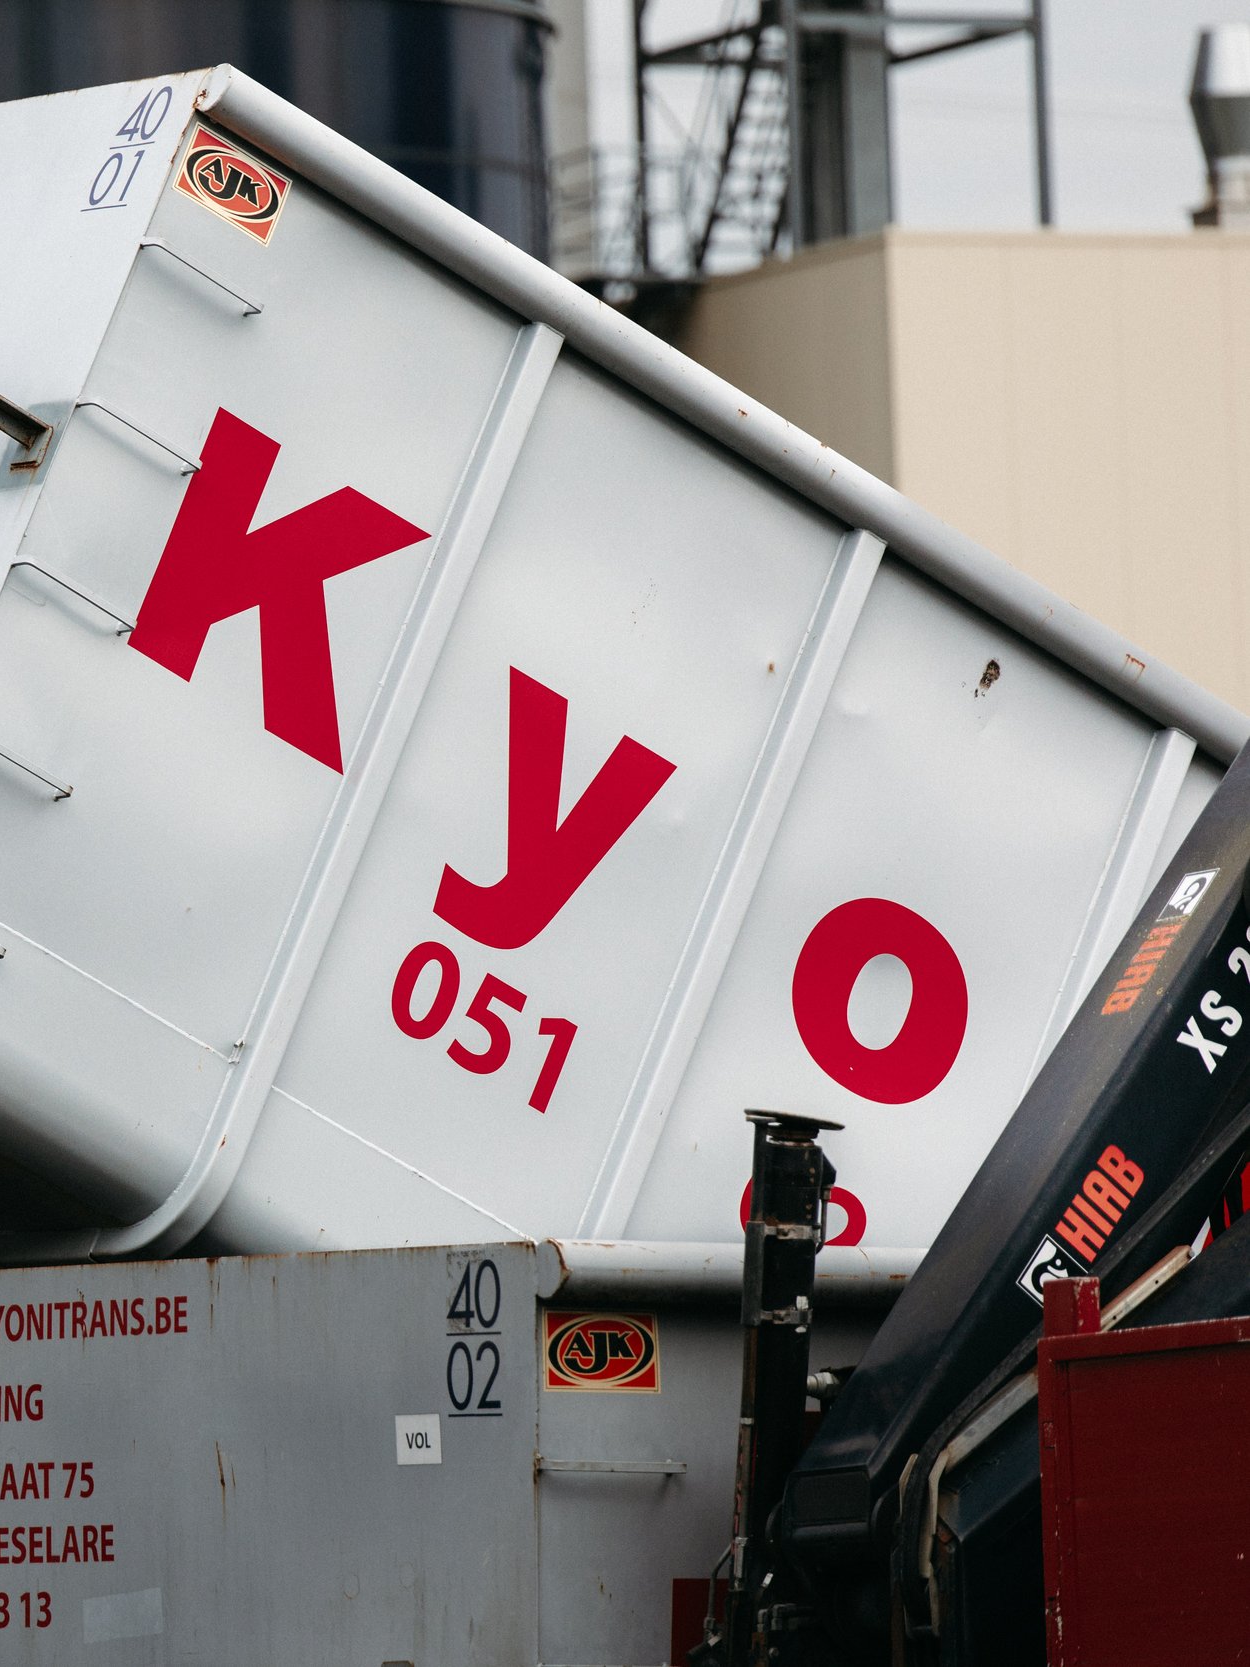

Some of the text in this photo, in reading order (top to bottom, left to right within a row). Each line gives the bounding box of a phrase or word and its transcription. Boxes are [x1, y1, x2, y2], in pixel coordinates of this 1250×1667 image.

[116, 86, 172, 141] 40
[89, 150, 145, 205] 01
[198, 157, 266, 209] AJK
[1101, 923, 1183, 1015] HIAB
[391, 940, 578, 1114] 051
[1176, 989, 1243, 1074] XS
[1055, 1144, 1145, 1263] HIAB
[447, 1259, 501, 1328] 40
[447, 1341, 501, 1410] 02
[563, 1330, 637, 1375] AJK
[406, 1432, 431, 1449] VOL
[62, 1463, 95, 1498] 75
[21, 1592, 52, 1627] 13
